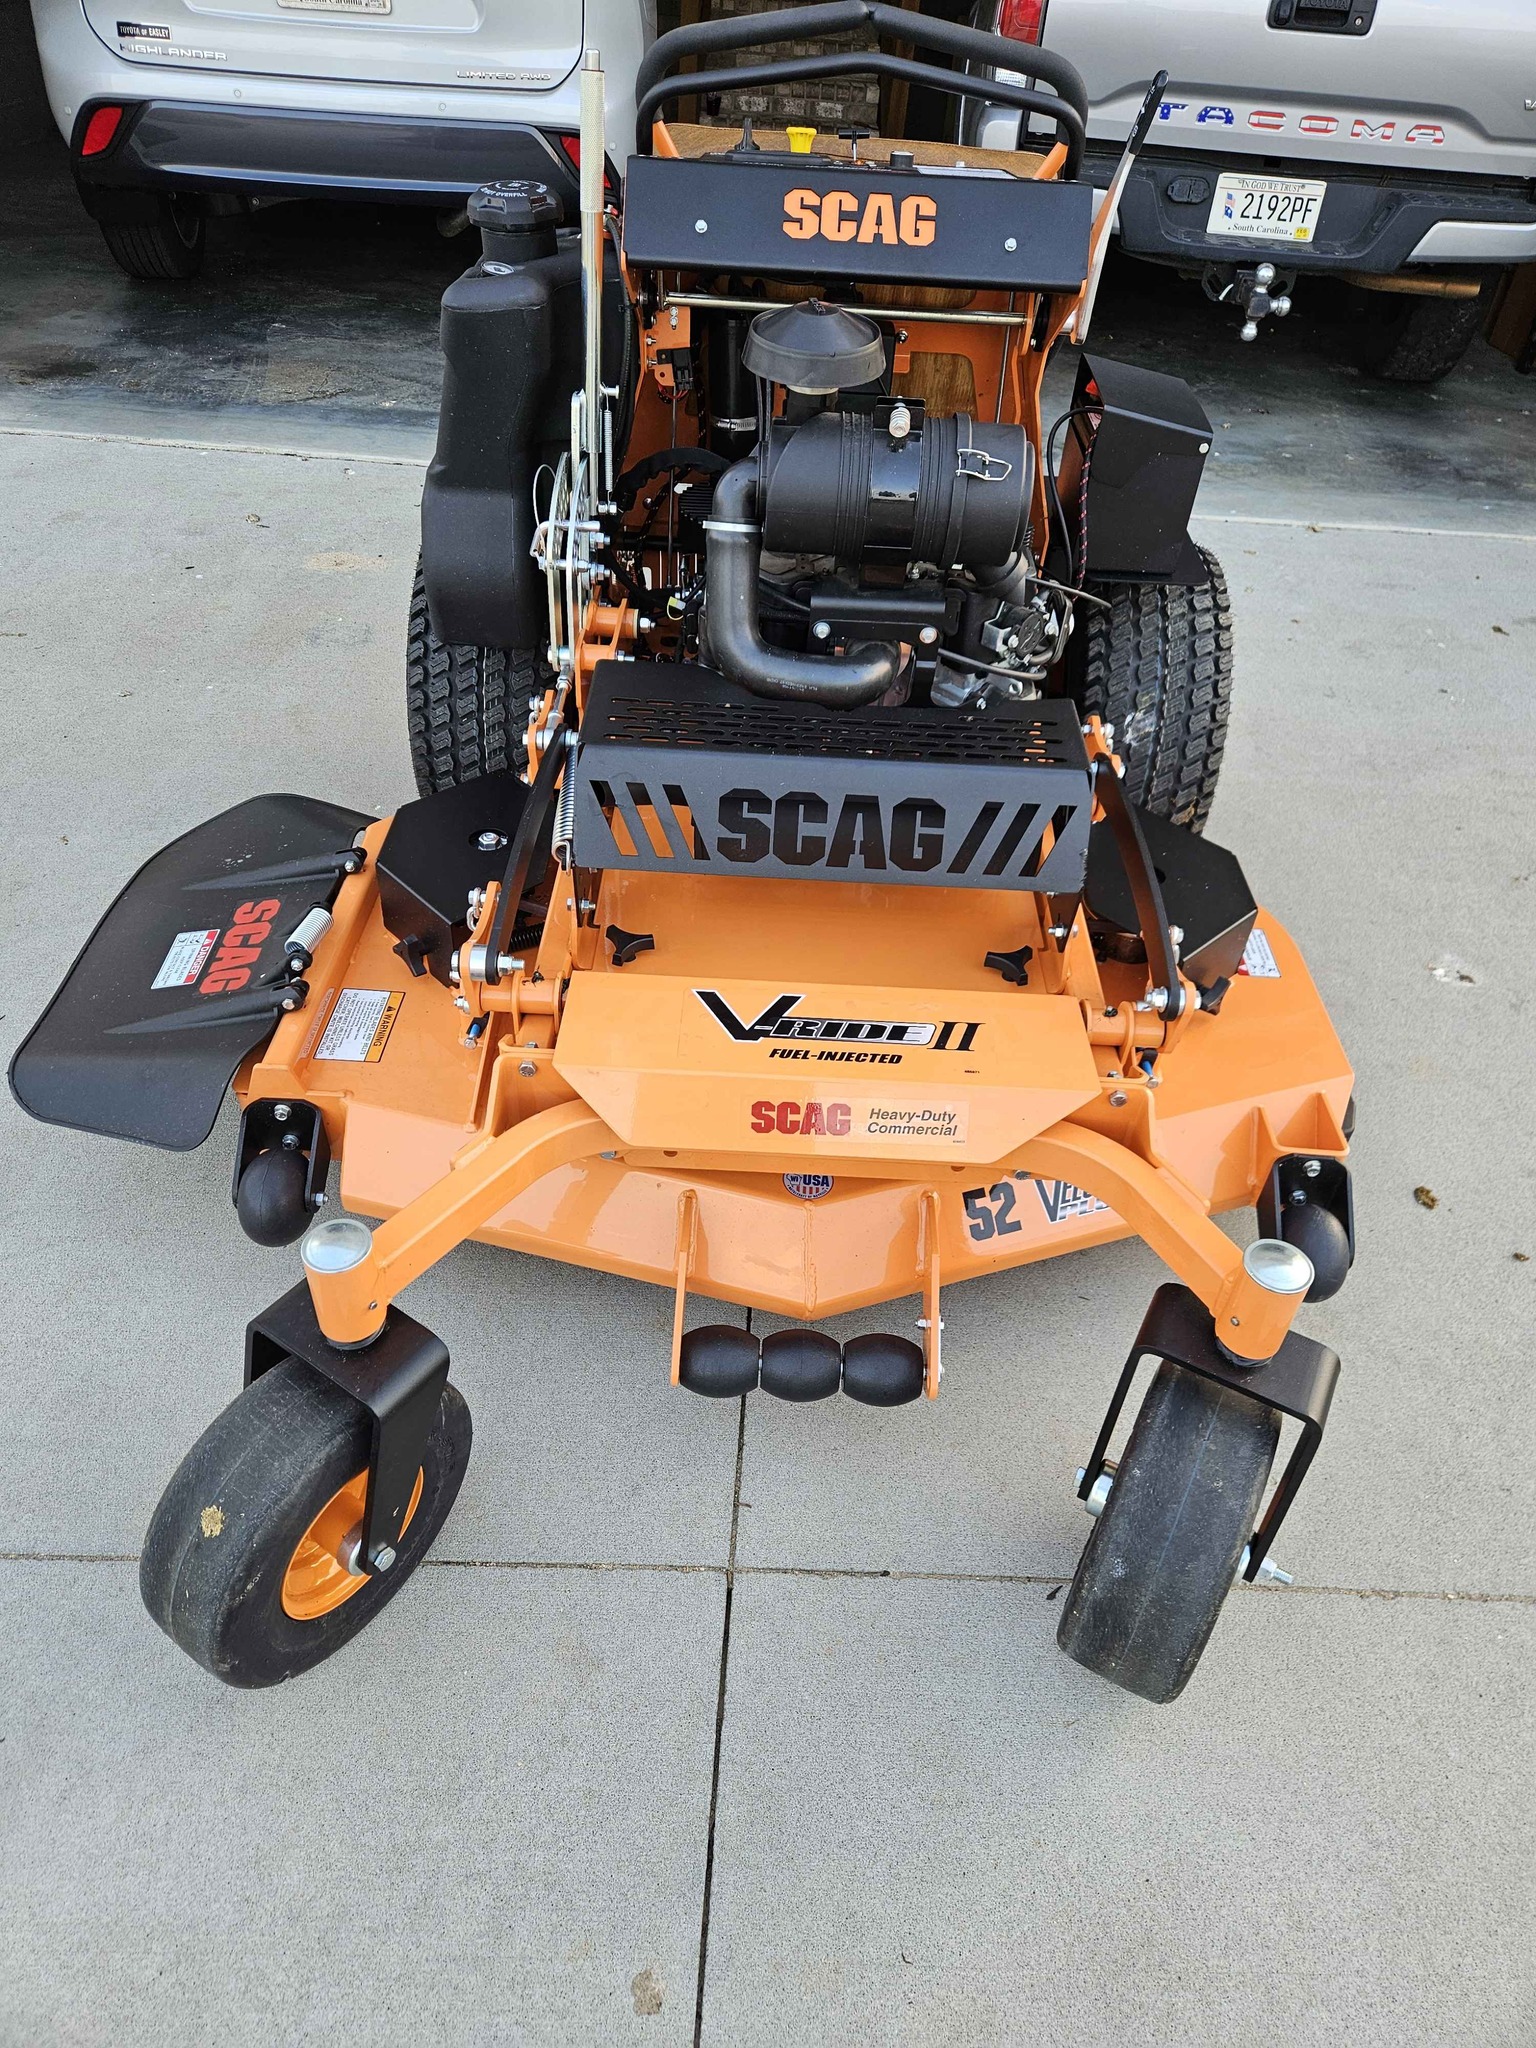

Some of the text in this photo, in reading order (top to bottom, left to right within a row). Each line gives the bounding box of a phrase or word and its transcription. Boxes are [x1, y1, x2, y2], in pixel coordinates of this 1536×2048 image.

[120, 25, 140, 35] TOYOTA
[148, 28, 169, 38] EASLEY
[119, 43, 228, 61] HIGHLANDER
[456, 70, 551, 81] LIMITED AWD
[1156, 101, 1447, 146] TACOMA
[1251, 180, 1267, 190] GOD
[782, 188, 937, 247] SCAG
[1240, 192, 1318, 224] 2192PF
[1232, 223, 1288, 236] South Carolina
[717, 787, 947, 873] SCAG
[189, 945, 210, 976] DANGER
[199, 899, 281, 994] SCAG
[373, 1013, 392, 1047] WARNING
[927, 1020, 985, 1052] II
[769, 1048, 903, 1065] FUEL-INJECTED
[751, 1100, 852, 1136] SCAG
[867, 1122, 958, 1137] Commercial
[869, 1108, 957, 1124] Heavy-Duty
[803, 1174, 830, 1187] USA
[962, 1181, 1022, 1242] 52
